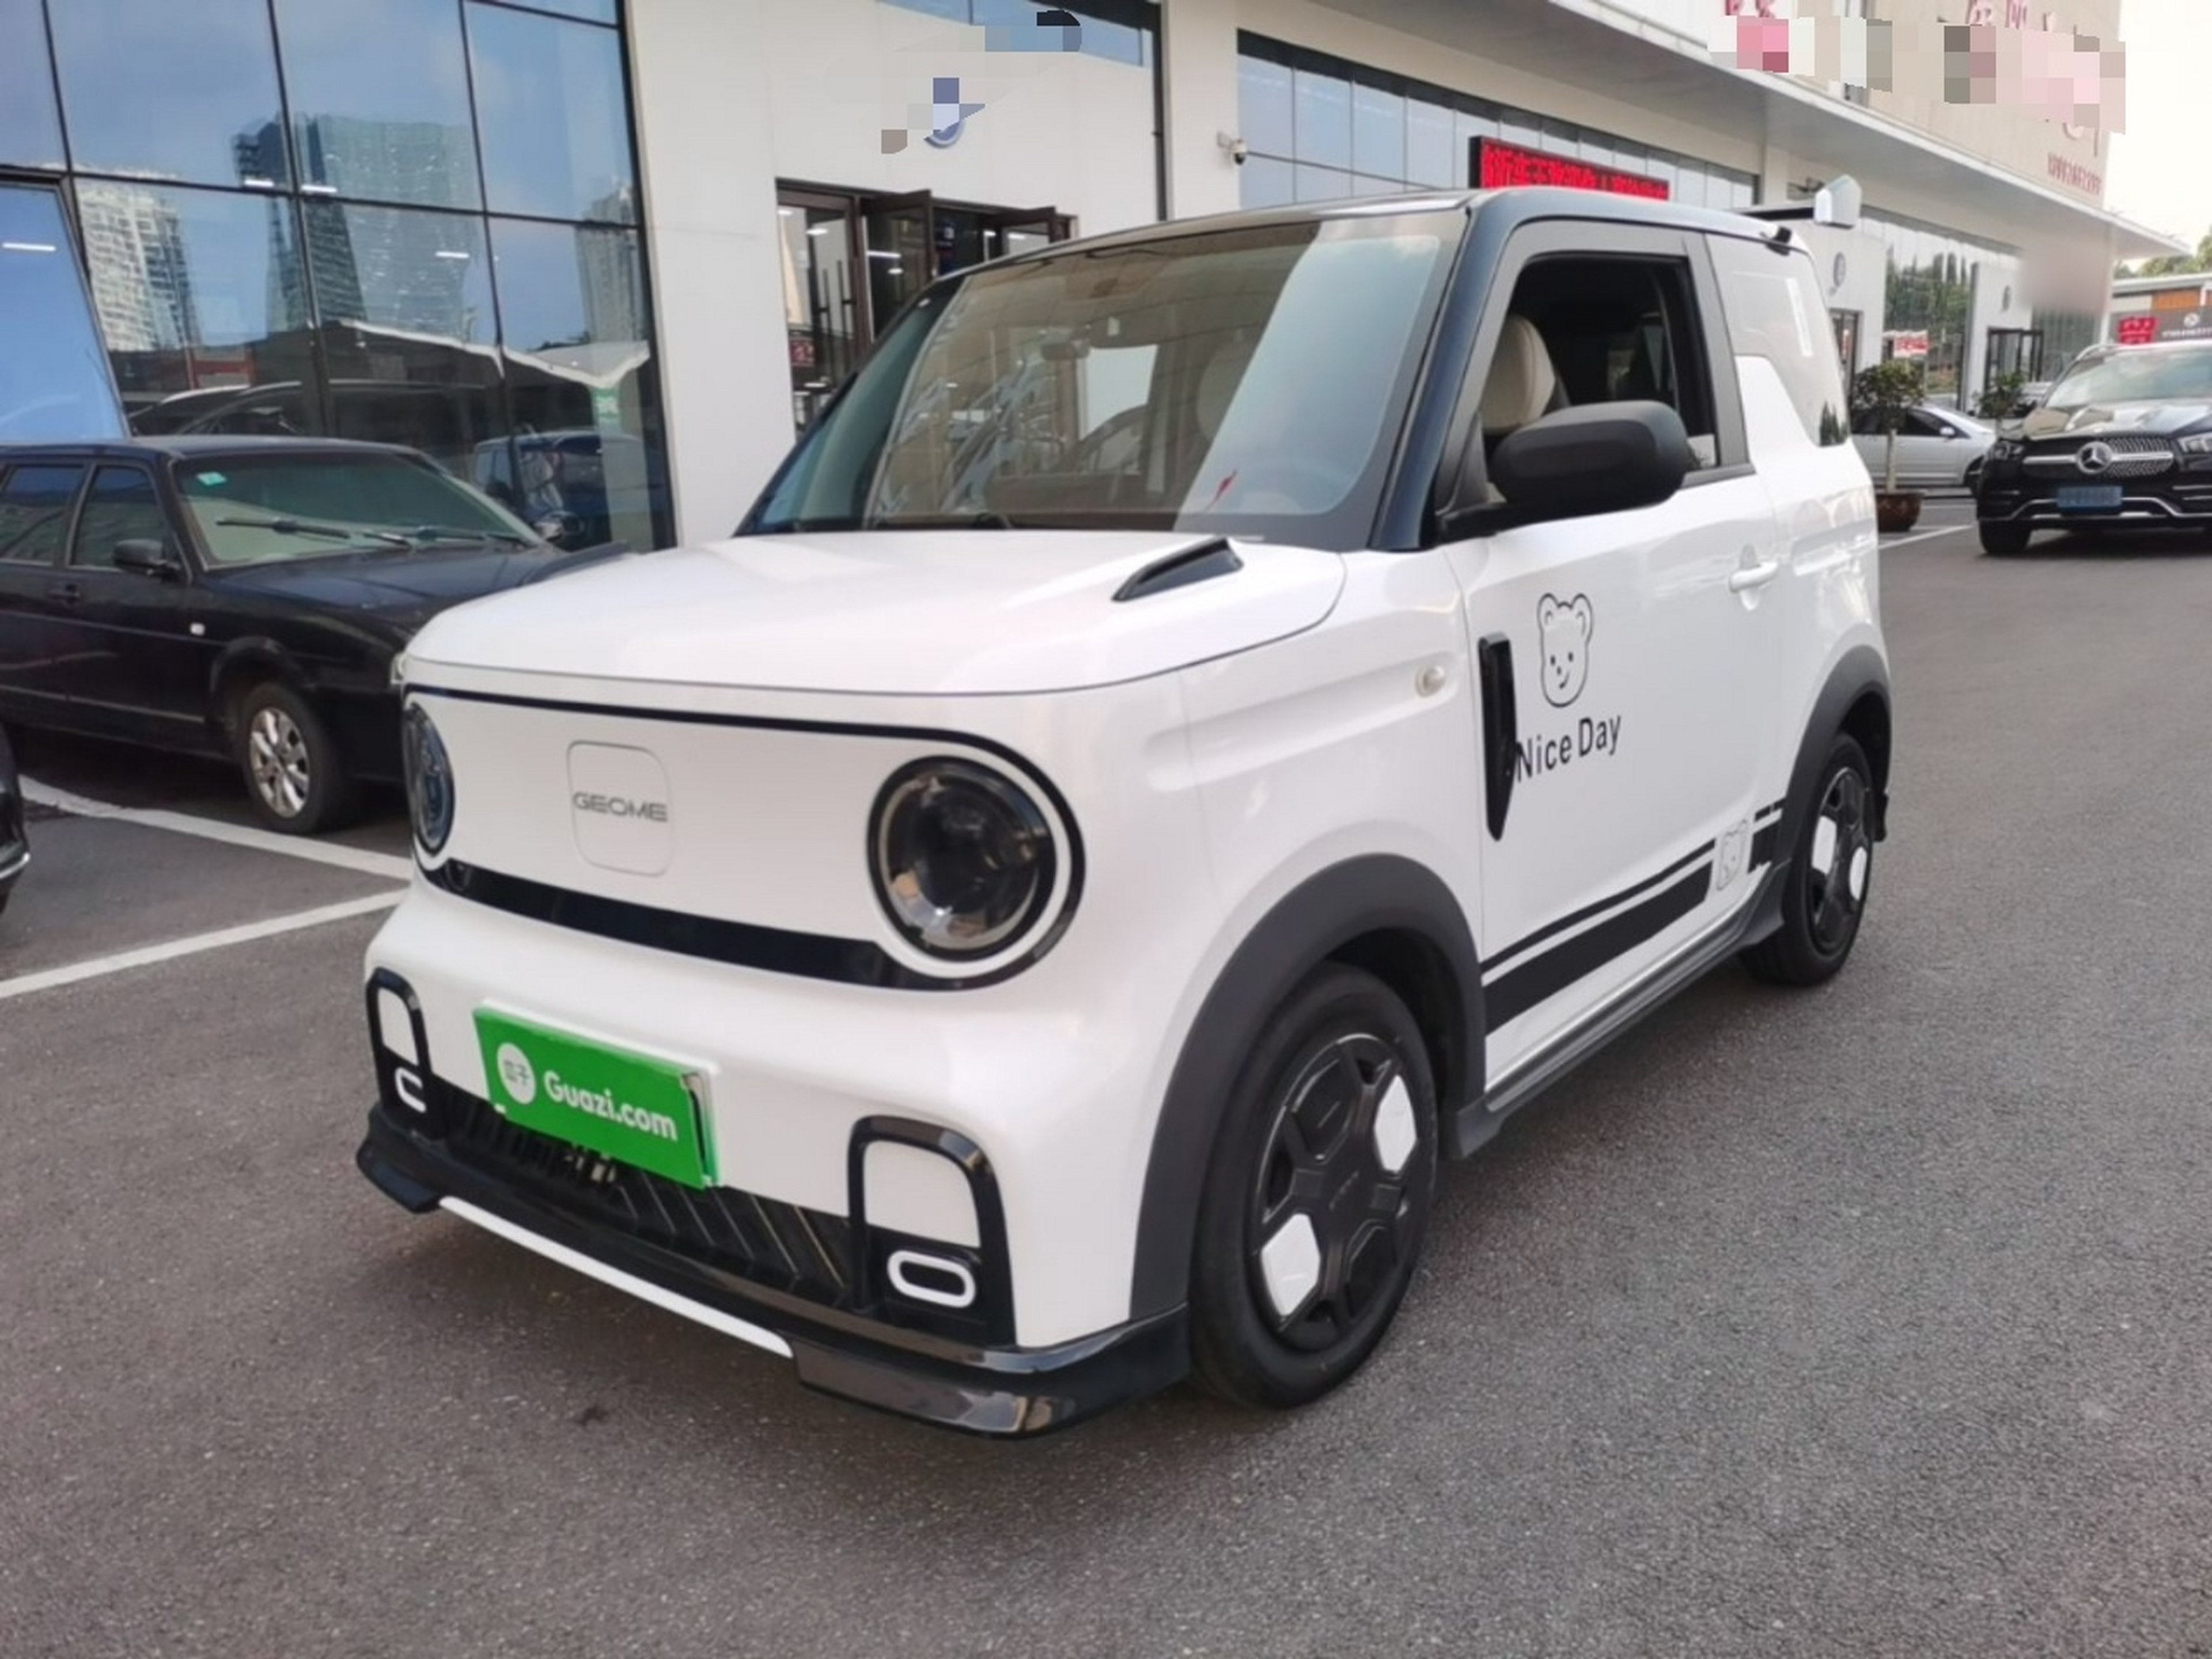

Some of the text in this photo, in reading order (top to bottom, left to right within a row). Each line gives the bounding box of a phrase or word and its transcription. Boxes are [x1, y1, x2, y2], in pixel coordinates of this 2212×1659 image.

[1516, 714, 1622, 783] Nice Day
[572, 791, 669, 823] GEOME
[543, 1069, 679, 1143] Guazi.com
